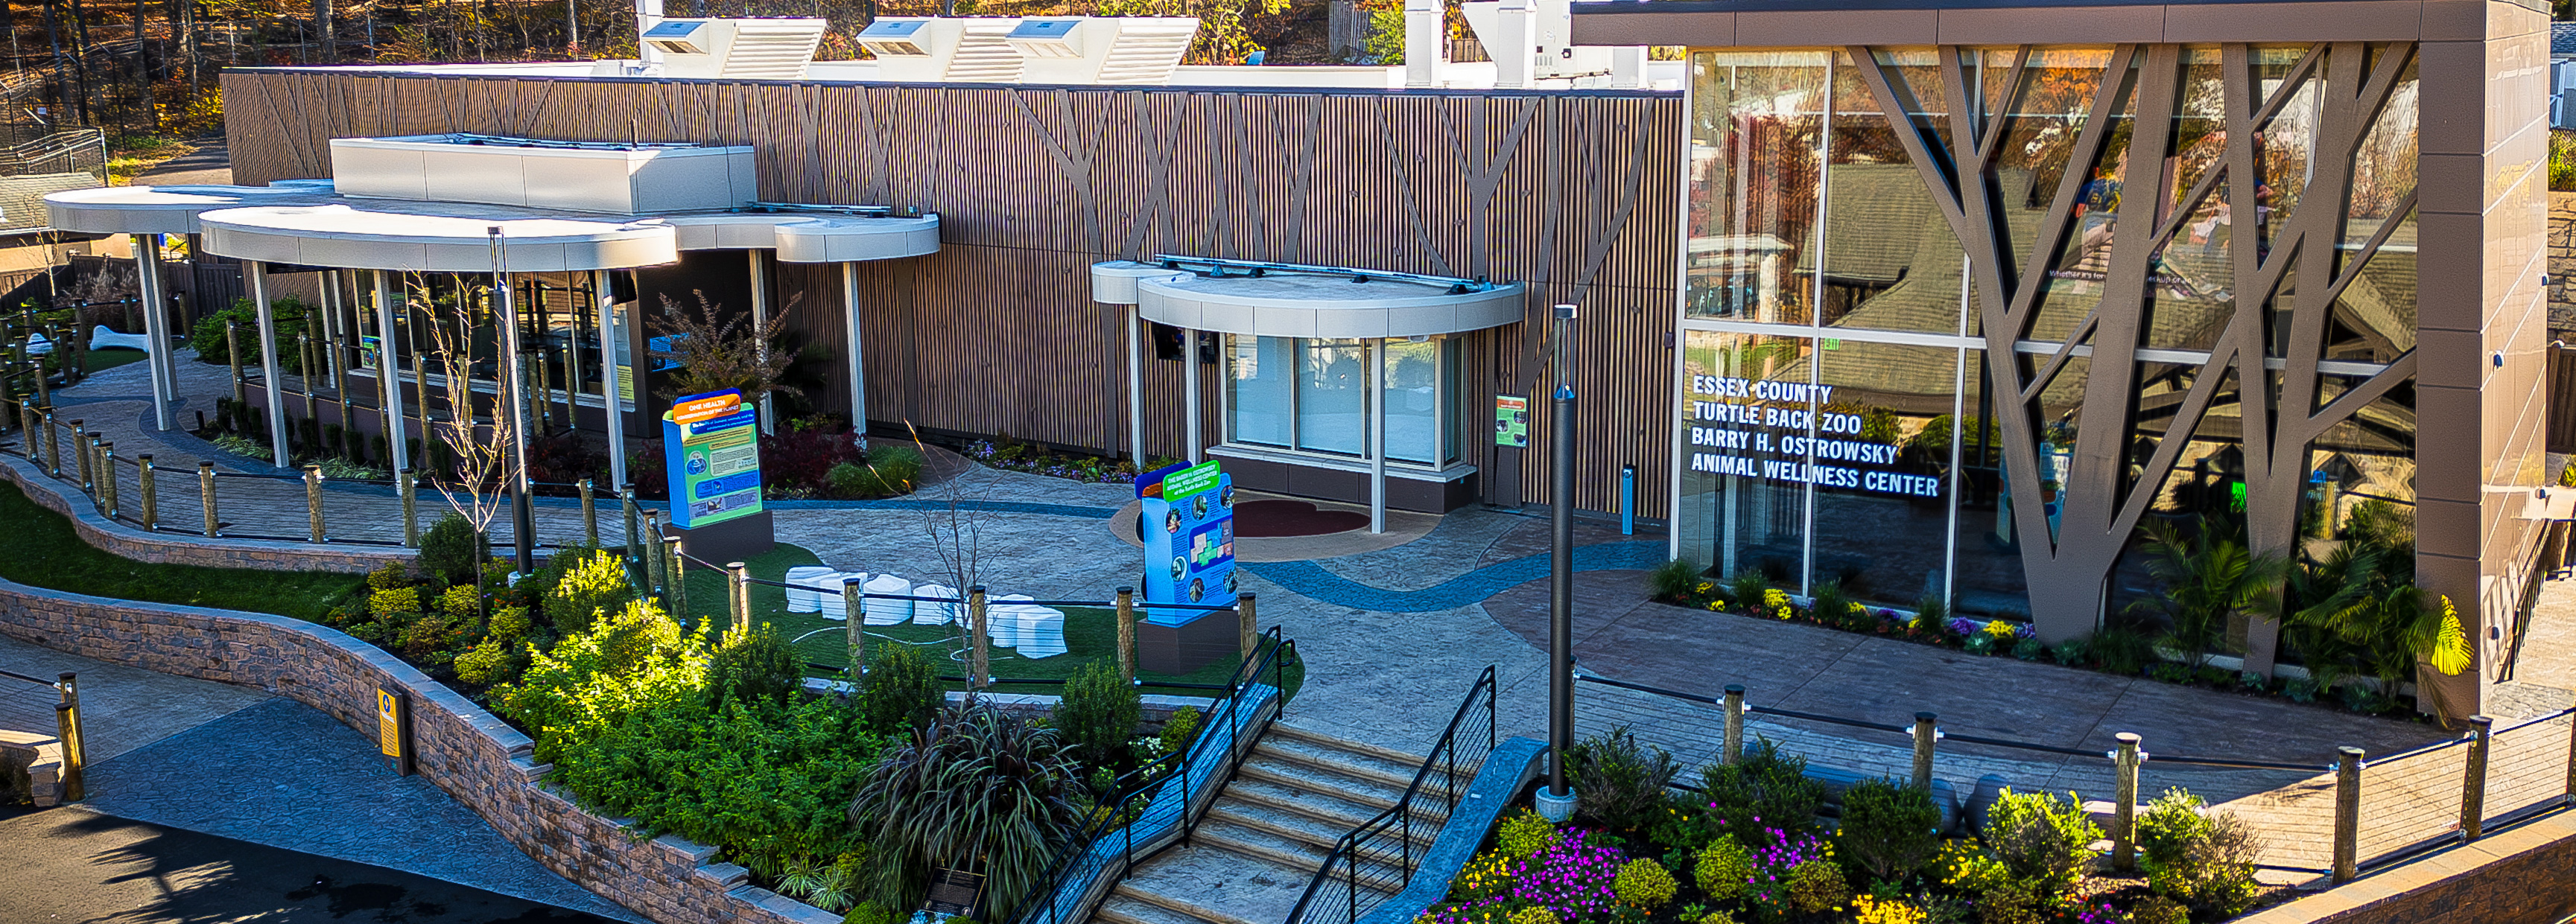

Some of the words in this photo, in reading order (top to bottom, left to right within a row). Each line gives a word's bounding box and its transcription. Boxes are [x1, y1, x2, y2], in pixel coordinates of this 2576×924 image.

[702, 400, 726, 410] HEALTH
[1693, 375, 1750, 398] ESSEX
[1756, 380, 1833, 404] COUNTY
[1693, 401, 1760, 425] TURTLE
[1766, 408, 1814, 430] BACK
[1821, 413, 1862, 434] ZOO
[1692, 427, 1750, 448] BARRY
[1757, 433, 1774, 452] H.
[1781, 436, 1897, 465] OSTROWSKY
[1167, 482, 1181, 491] ANIMAL
[1182, 475, 1202, 485] WELLNESS
[1202, 471, 1217, 479] CENTER
[1691, 453, 1758, 477] ANIMAL
[1764, 460, 1858, 488] WELLNESS
[1865, 471, 1938, 497] CENTER
